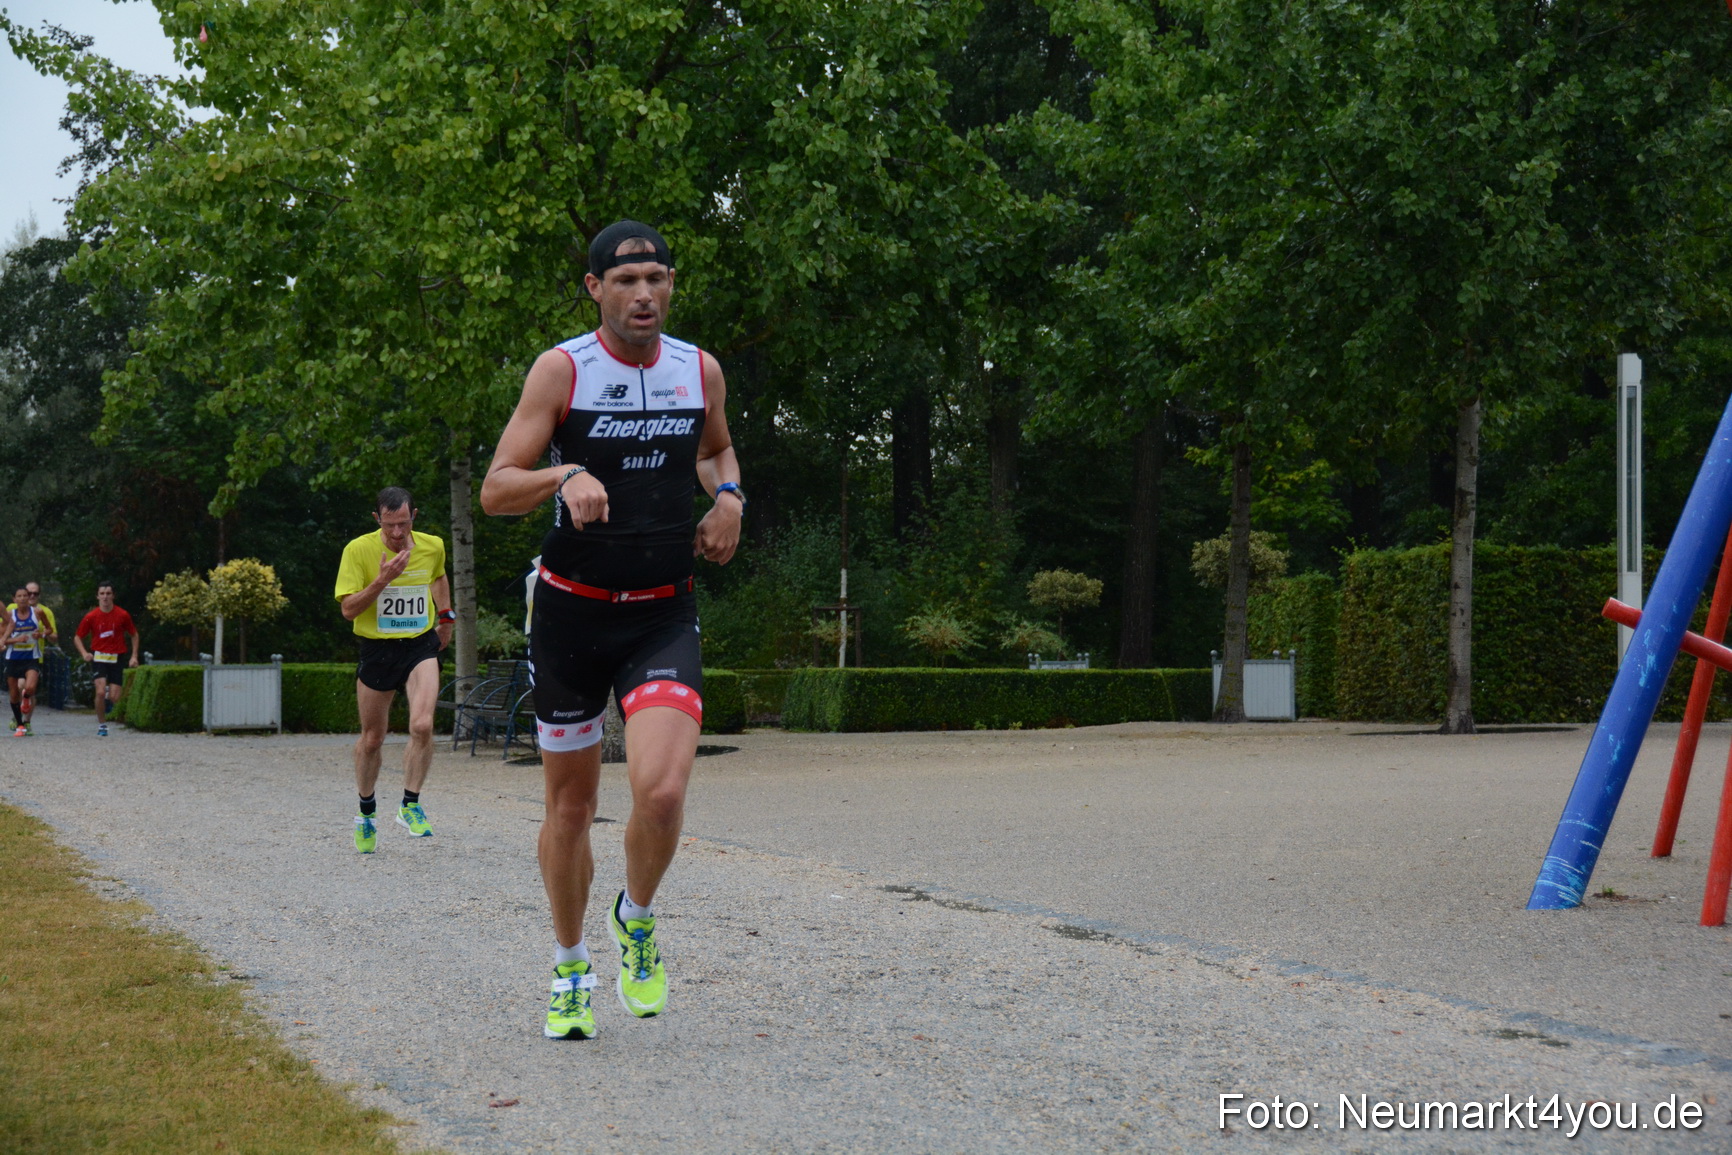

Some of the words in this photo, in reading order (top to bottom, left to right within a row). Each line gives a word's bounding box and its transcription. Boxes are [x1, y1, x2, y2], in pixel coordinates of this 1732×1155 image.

[588, 415, 695, 441] Energizer
[383, 597, 425, 615] 2010
[553, 710, 585, 718] Energizer
